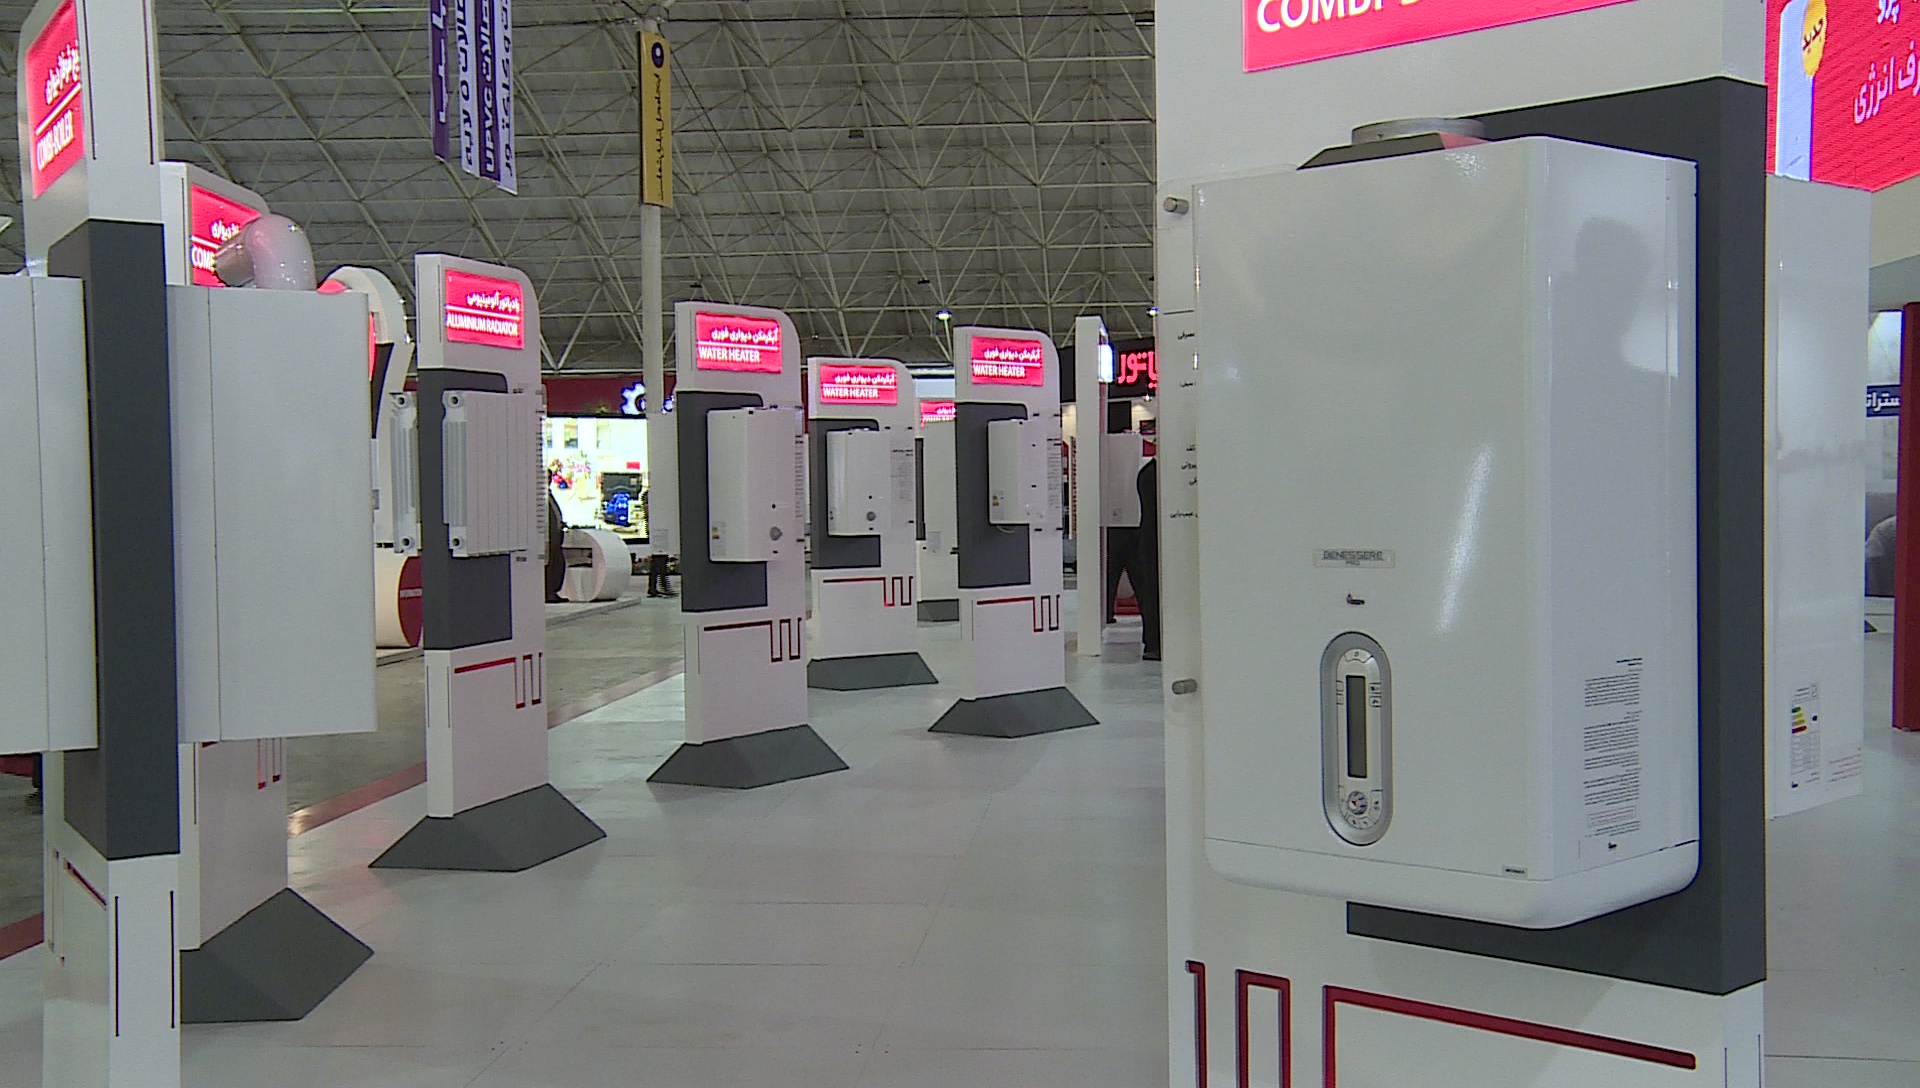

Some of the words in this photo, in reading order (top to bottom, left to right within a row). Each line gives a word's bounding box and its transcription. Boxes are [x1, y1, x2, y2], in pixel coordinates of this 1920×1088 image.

[1853, 56, 1895, 125] انرژی
[484, 86, 495, 173] UPVC
[446, 312, 486, 332] ALUMINIUM
[486, 317, 518, 337] RADIATOR
[729, 327, 752, 344] دیواری
[698, 346, 728, 360] WATER
[728, 348, 760, 363] HEATER
[973, 364, 998, 377] WATER
[998, 365, 1026, 378] HEATER
[823, 387, 849, 398] WATER
[849, 388, 879, 399] HEATER
